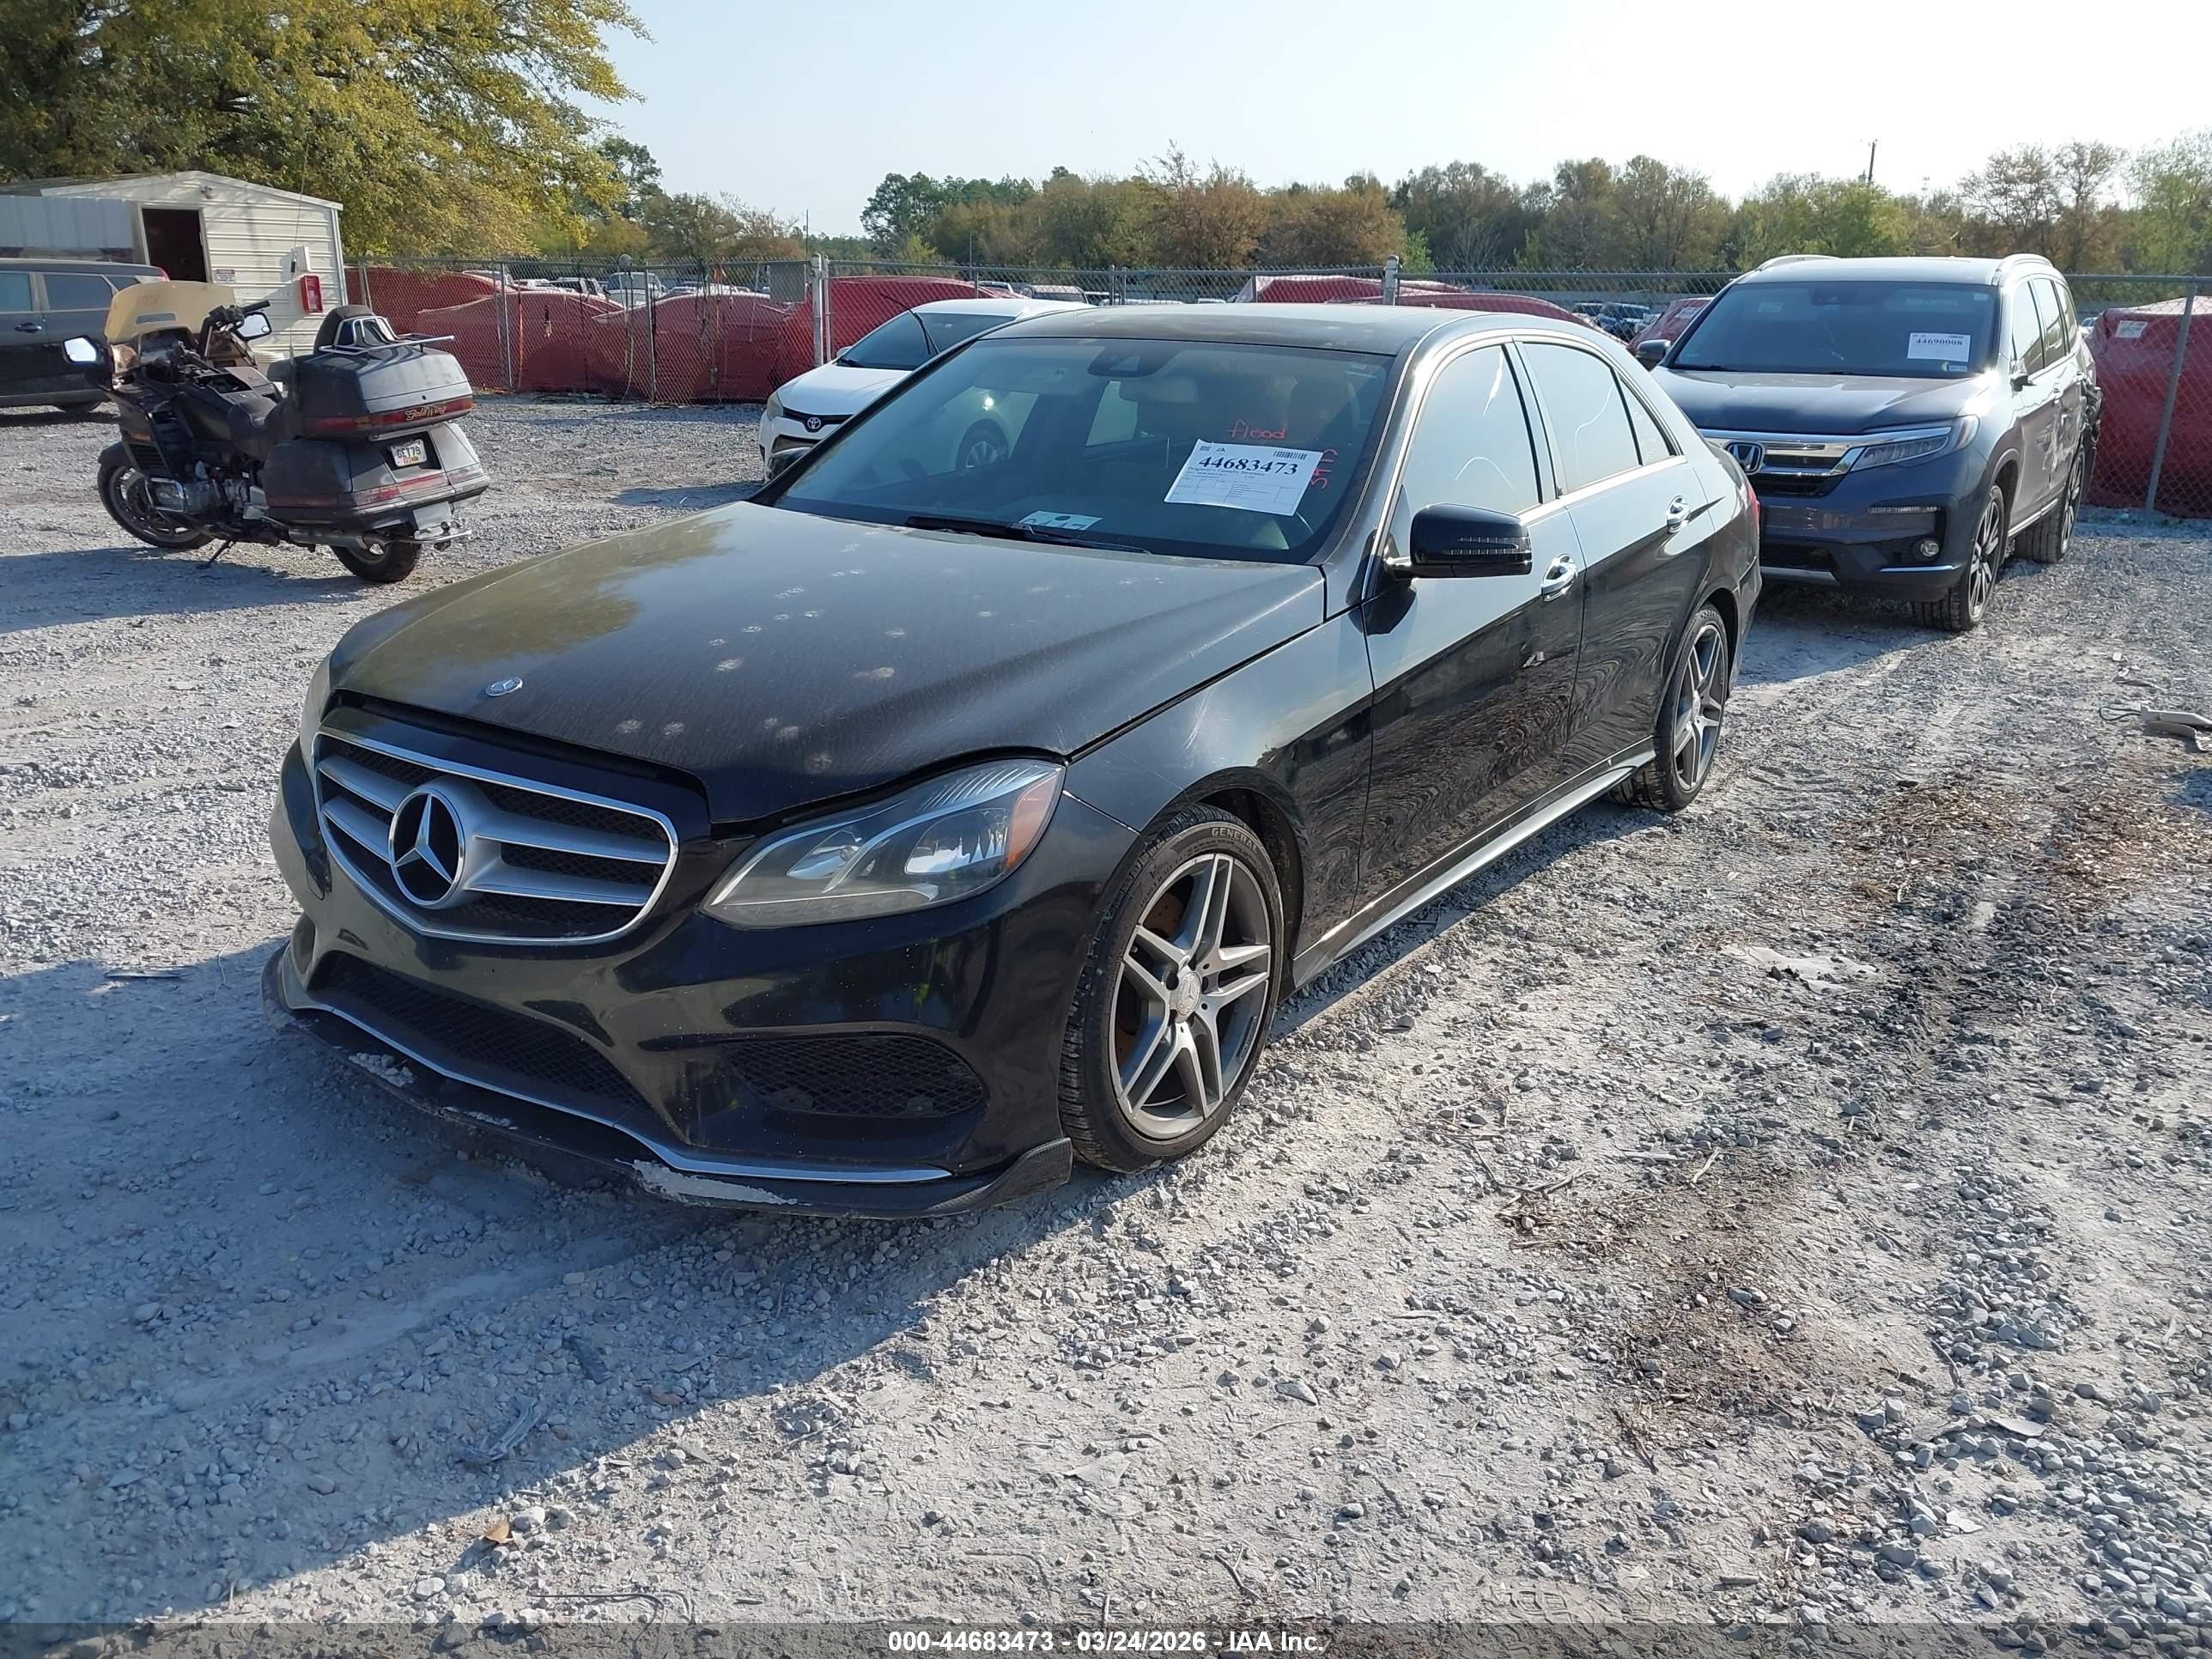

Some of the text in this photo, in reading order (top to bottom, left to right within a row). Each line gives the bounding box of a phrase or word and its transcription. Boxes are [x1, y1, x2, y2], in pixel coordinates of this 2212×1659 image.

[1227, 419, 1286, 439] flood
[1199, 456, 1299, 476] 44683473
[1211, 827, 1259, 854] GENERAL
